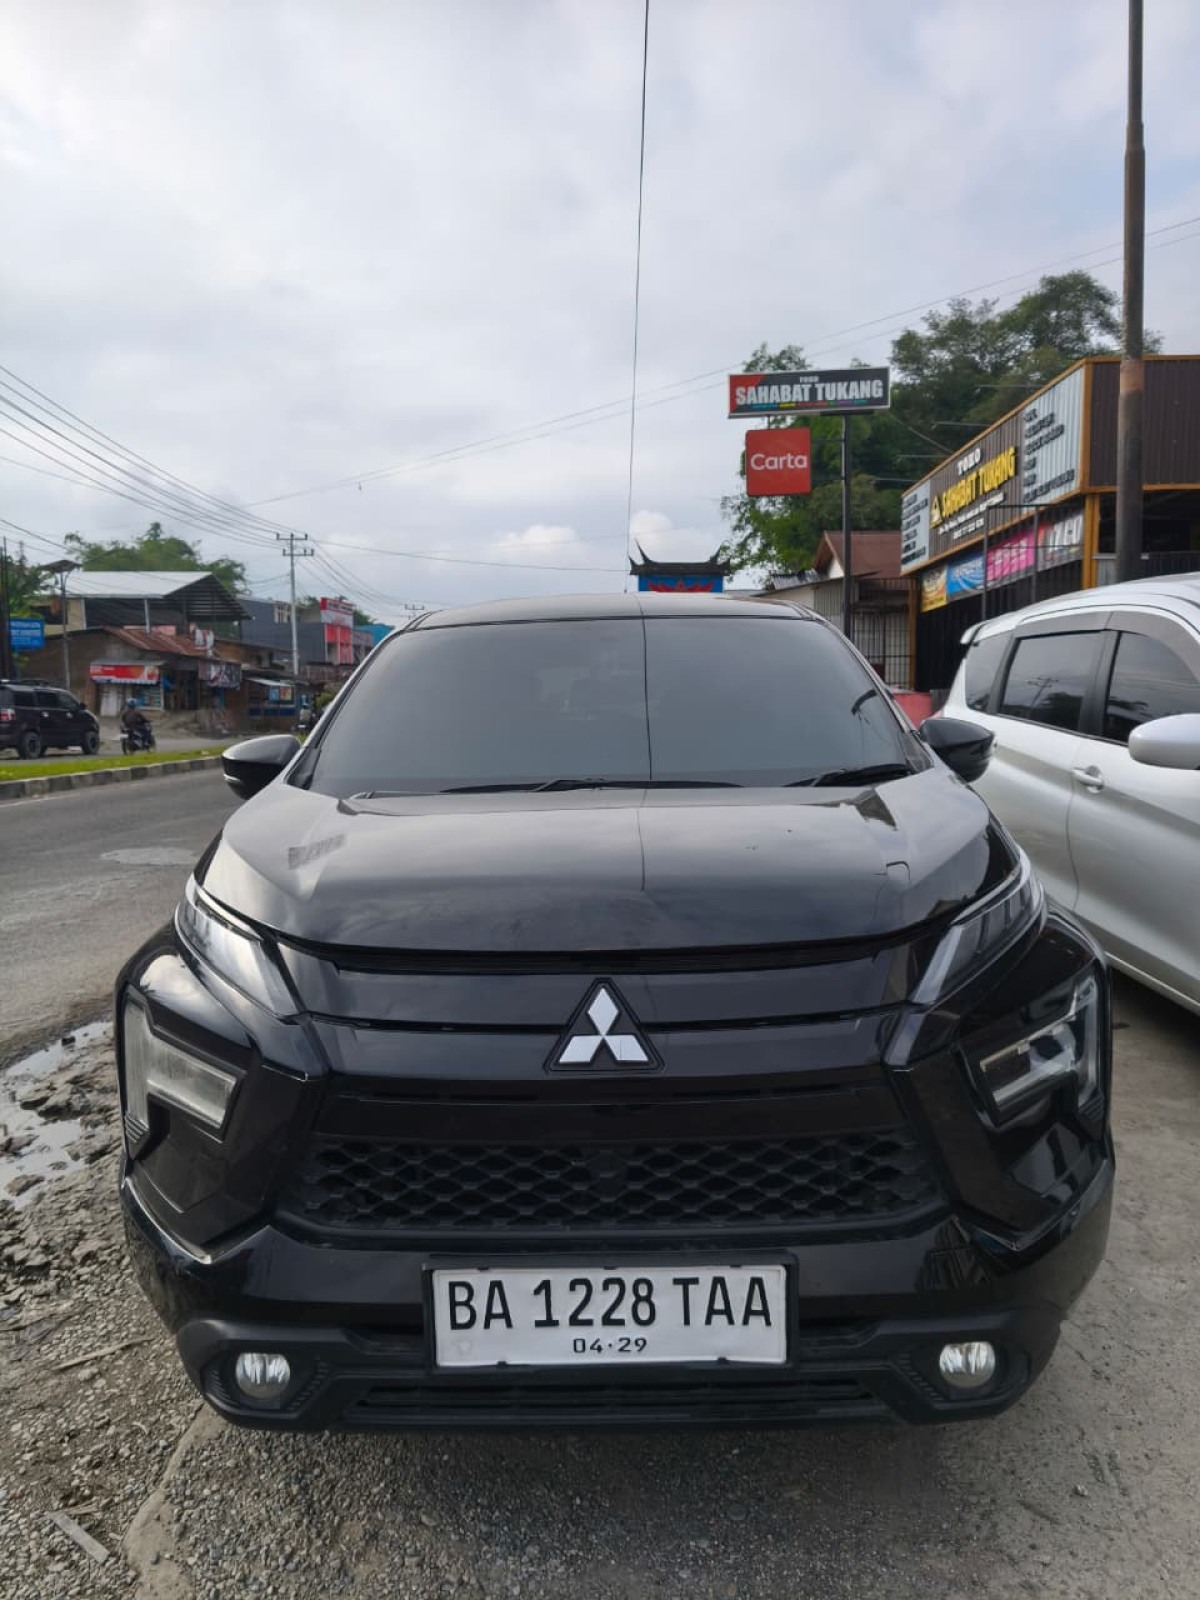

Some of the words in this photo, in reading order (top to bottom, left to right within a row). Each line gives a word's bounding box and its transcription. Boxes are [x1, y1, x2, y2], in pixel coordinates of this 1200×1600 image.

[736, 384, 811, 405] SAHABAT
[815, 380, 883, 401] TUKANG
[750, 453, 808, 471] Carta
[448, 1280, 513, 1331] BA
[533, 1277, 656, 1327] 1228
[672, 1276, 772, 1326] TAA
